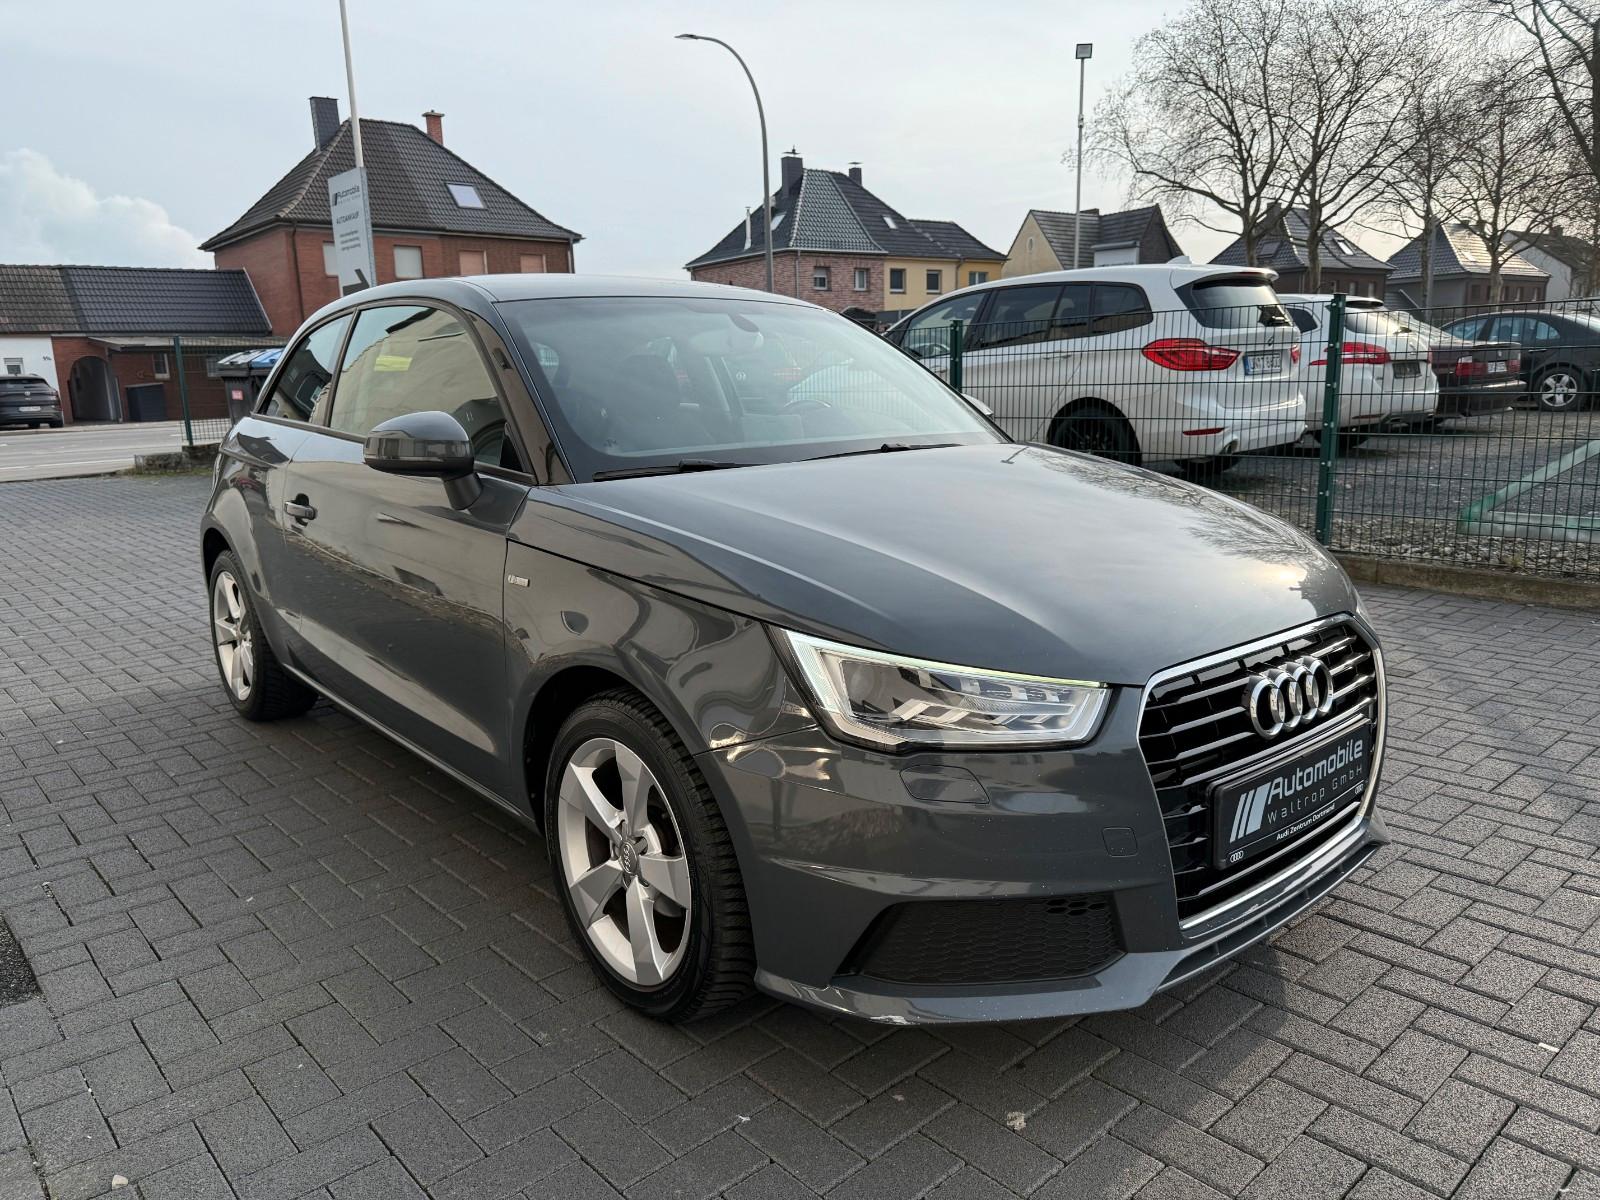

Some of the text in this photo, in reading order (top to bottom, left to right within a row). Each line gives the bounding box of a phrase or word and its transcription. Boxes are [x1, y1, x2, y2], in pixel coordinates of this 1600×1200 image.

[1267, 739, 1363, 805] Automobile
[1267, 763, 1363, 824] Waltrop GmbH
[1276, 803, 1336, 841] Audi Zentrum Dortmund
